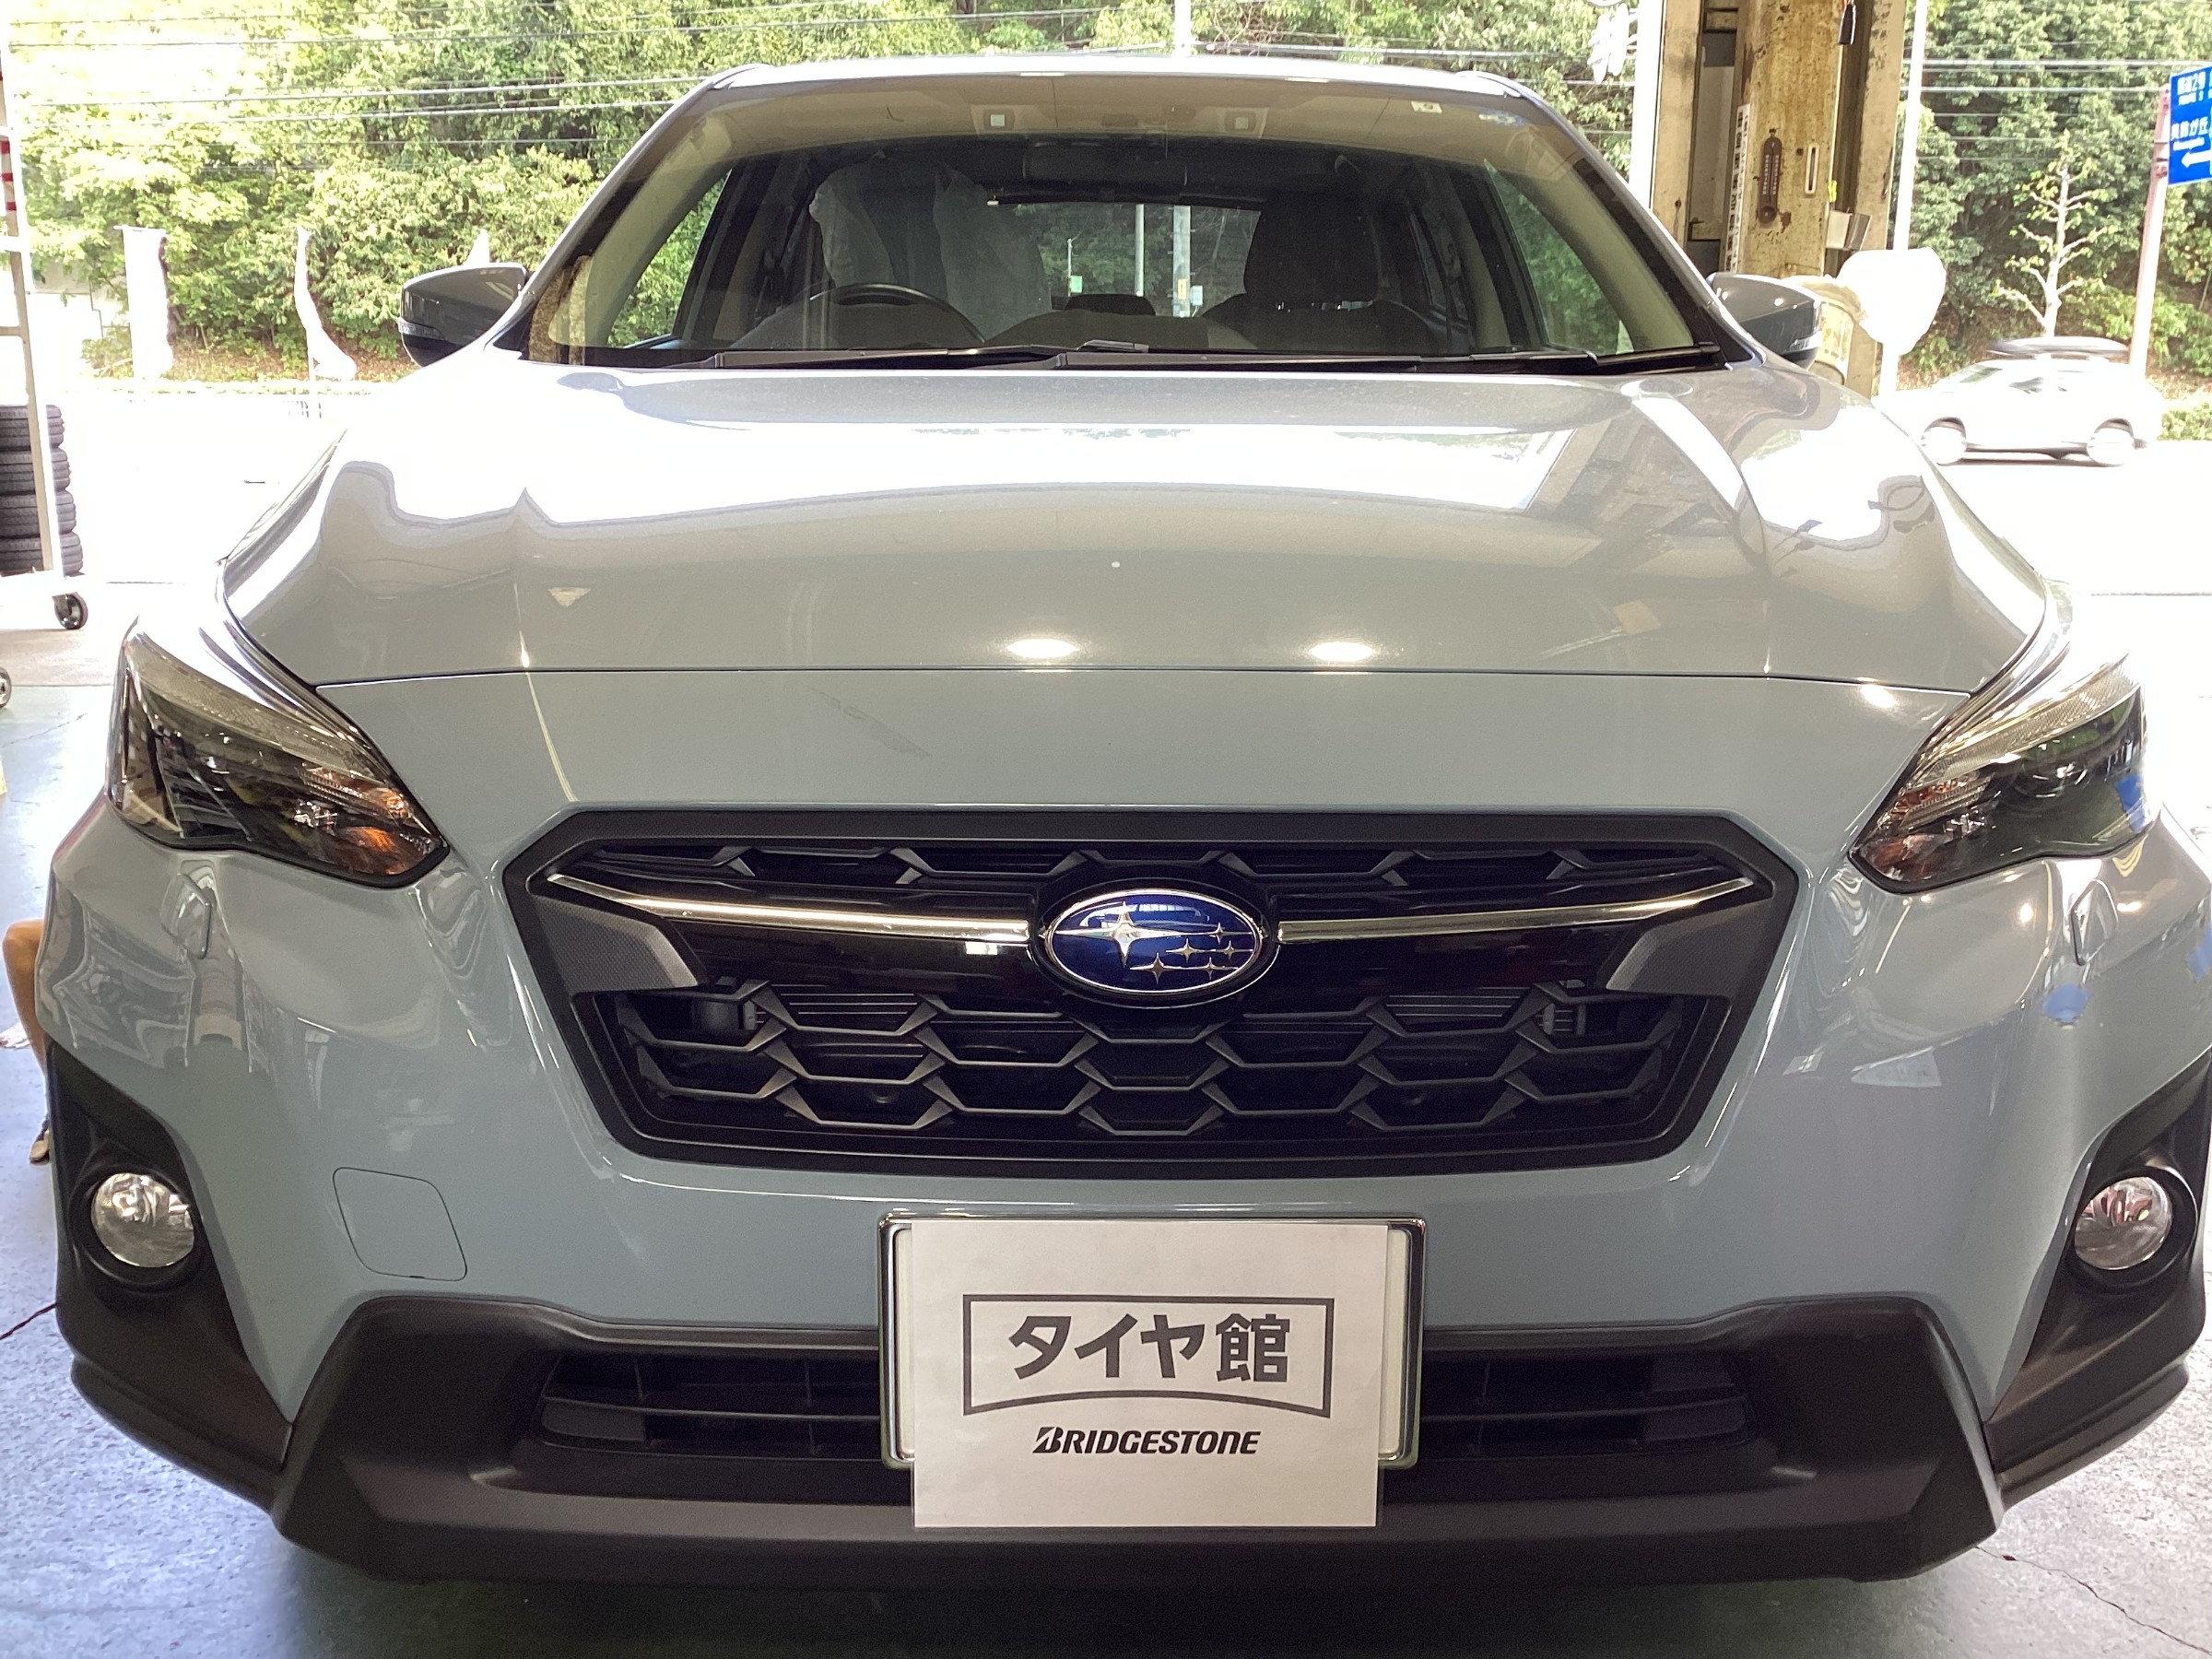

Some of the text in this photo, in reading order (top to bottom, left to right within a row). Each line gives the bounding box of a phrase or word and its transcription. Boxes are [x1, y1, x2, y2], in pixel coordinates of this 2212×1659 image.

[1008, 1312, 1290, 1382] タイヤ館
[1032, 1426, 1262, 1454] BRIDGESTONE
